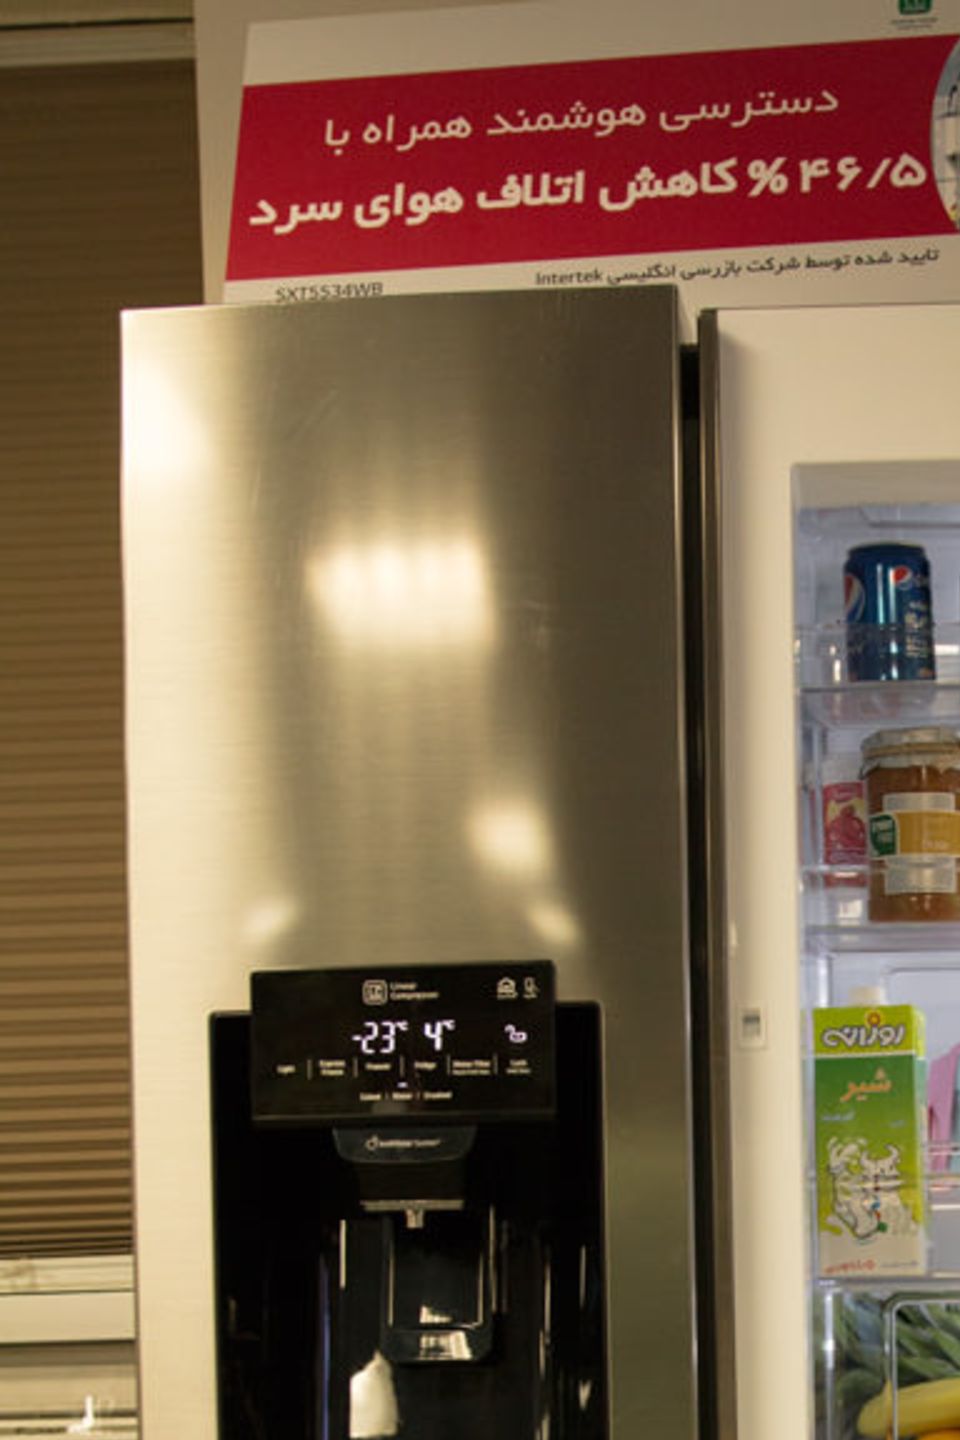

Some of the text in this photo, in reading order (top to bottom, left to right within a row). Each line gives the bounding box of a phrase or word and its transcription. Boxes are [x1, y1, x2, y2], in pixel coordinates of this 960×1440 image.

[324, 89, 839, 156] دسترسی هوشمند همراه با
[476, 169, 585, 209] اتلاف
[599, 156, 738, 212] کاهش
[249, 198, 343, 235] سرد
[353, 182, 464, 229] هوای
[680, 262, 742, 279] بازرسی
[746, 256, 800, 273] شرکت
[804, 253, 851, 270] توسط
[855, 250, 892, 266] شده
[535, 268, 602, 286] Intertek
[608, 264, 676, 285] انگلیسی
[839, 1067, 892, 1102] شیر
